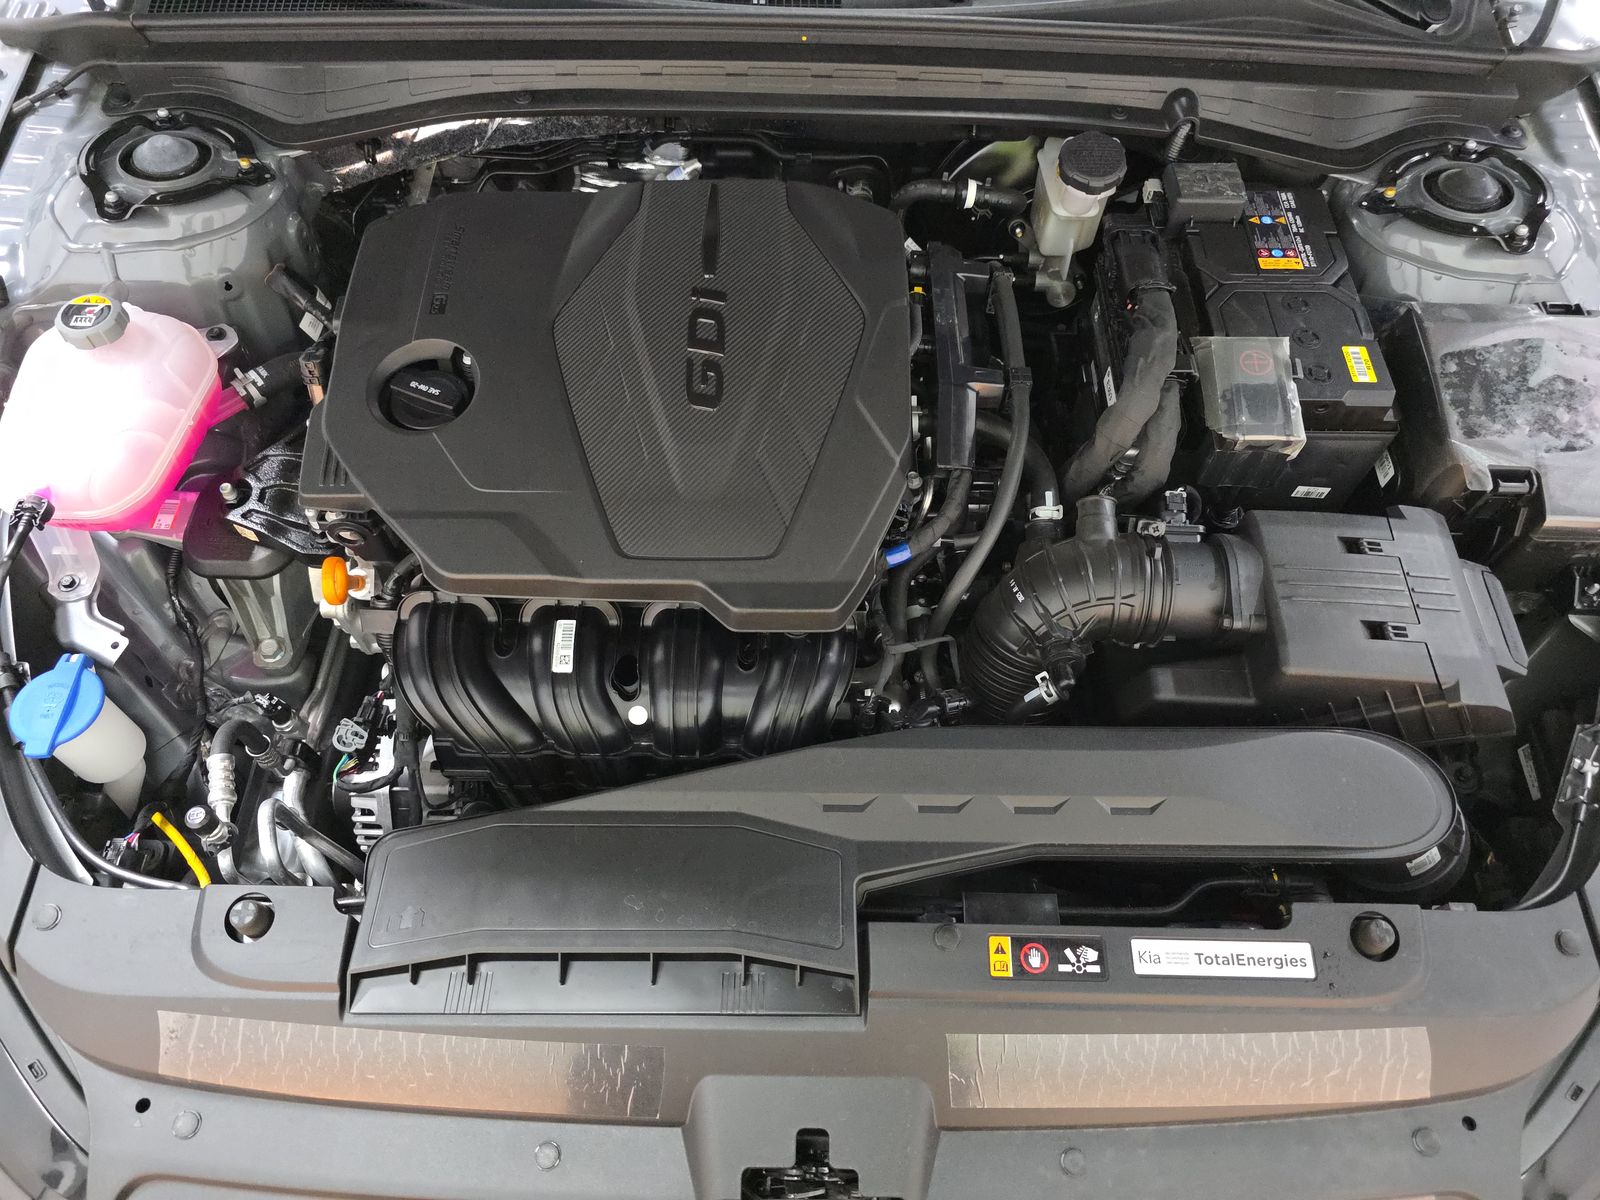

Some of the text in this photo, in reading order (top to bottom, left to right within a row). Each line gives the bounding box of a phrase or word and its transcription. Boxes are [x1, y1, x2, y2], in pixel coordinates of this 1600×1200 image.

[428, 387, 441, 395] SAE
[1137, 950, 1162, 965] Kia
[1195, 952, 1307, 969] TotalEnergies
